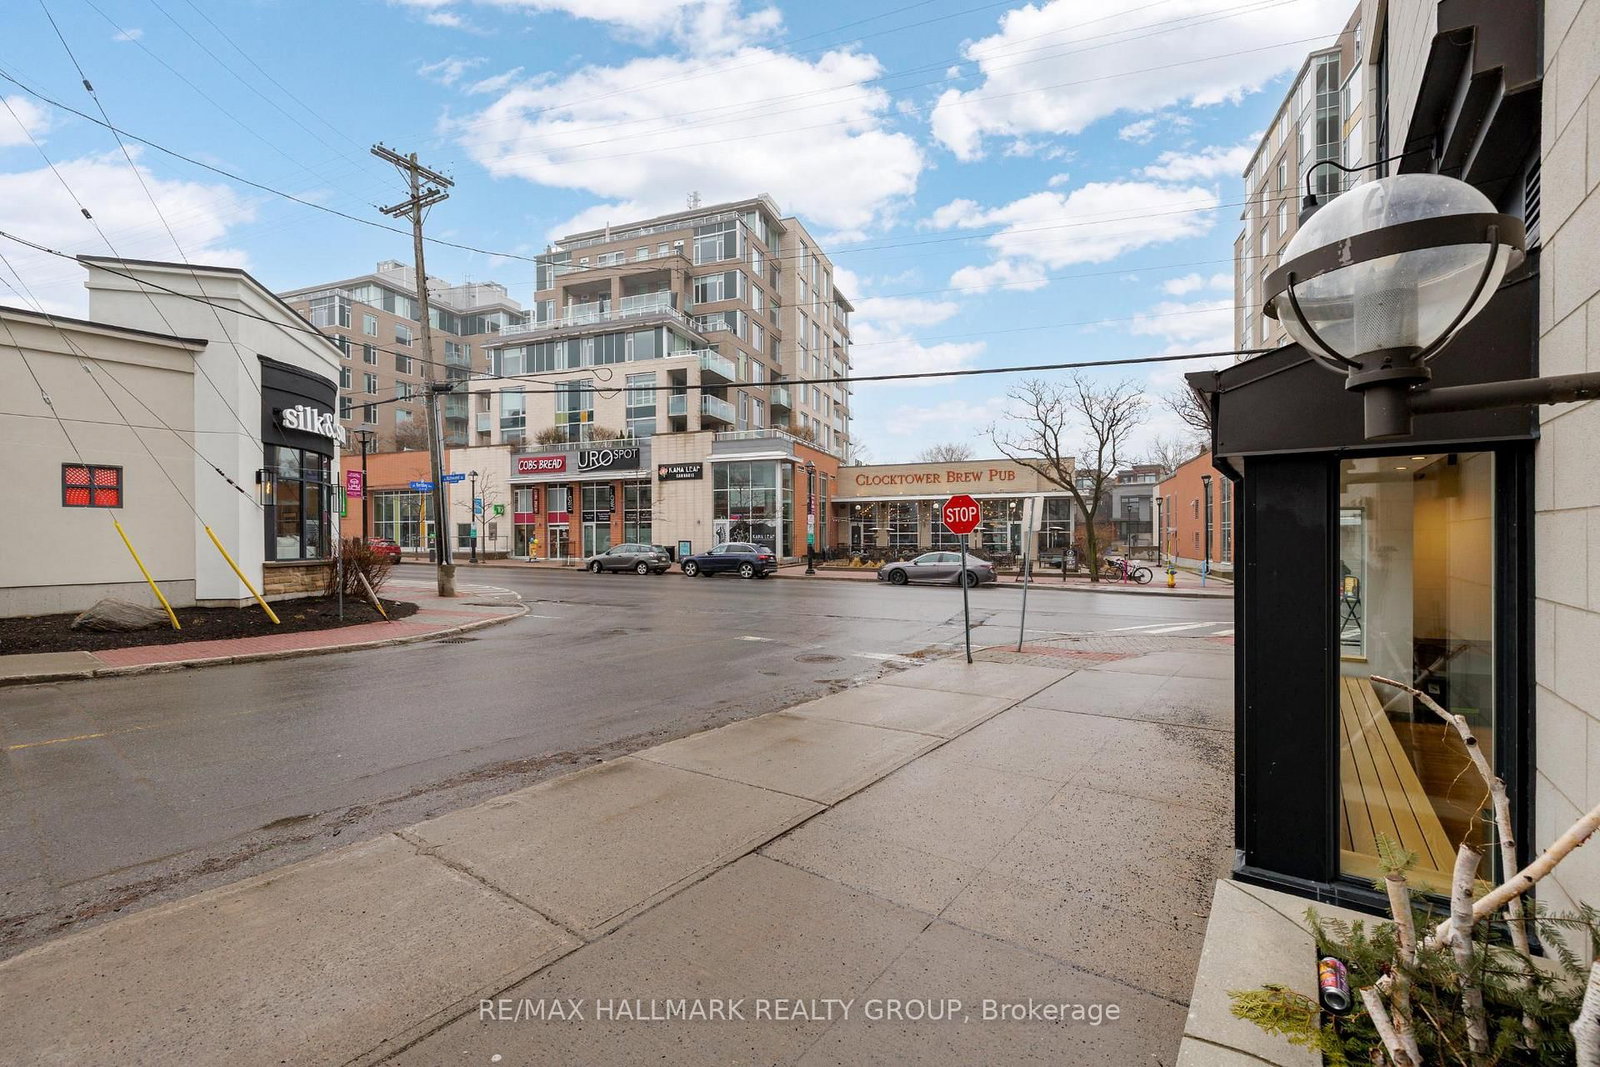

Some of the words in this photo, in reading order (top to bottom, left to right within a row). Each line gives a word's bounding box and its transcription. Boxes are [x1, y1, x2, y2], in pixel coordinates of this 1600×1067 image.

[519, 460, 537, 470] COBS
[539, 458, 562, 469] BREAD
[578, 449, 613, 468] URO
[613, 448, 638, 459] SPOT
[946, 506, 977, 523] STOP
